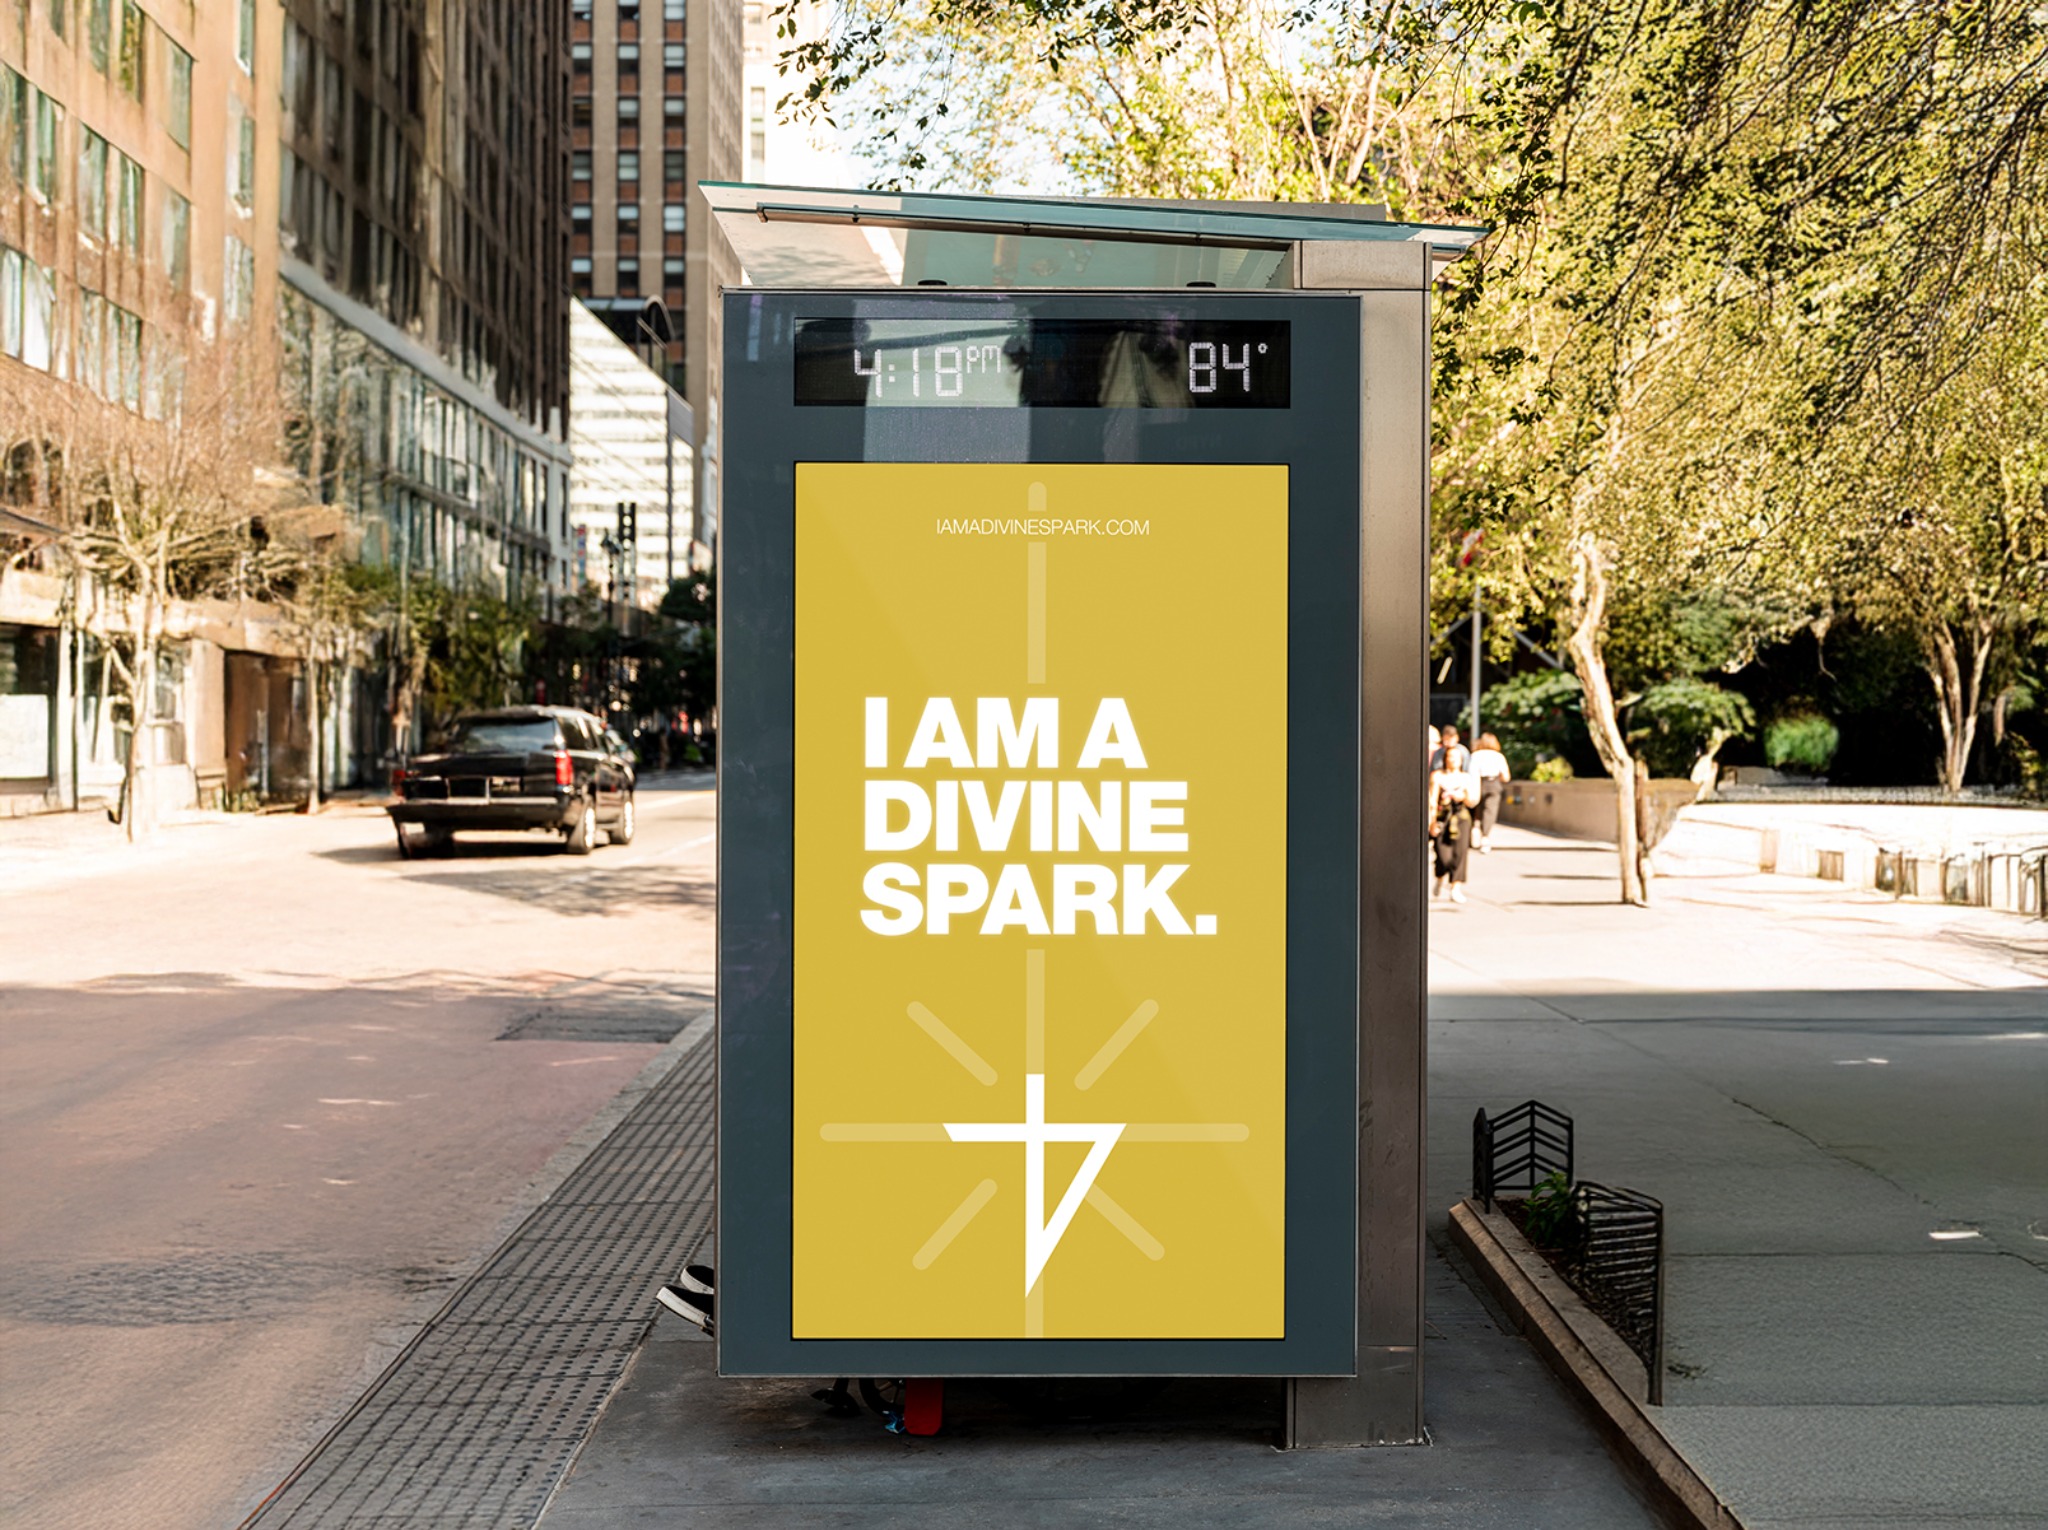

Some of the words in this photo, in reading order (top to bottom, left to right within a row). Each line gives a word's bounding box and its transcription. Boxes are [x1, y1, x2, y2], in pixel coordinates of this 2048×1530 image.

[854, 346, 963, 397] 4:18
[936, 518, 1150, 536] IAMADIVINESPARK.COM
[865, 697, 888, 768] I
[903, 697, 1059, 769] AM
[1076, 697, 1149, 769] A
[864, 780, 1189, 852] DIVINE
[860, 862, 1218, 936] SPARK.
